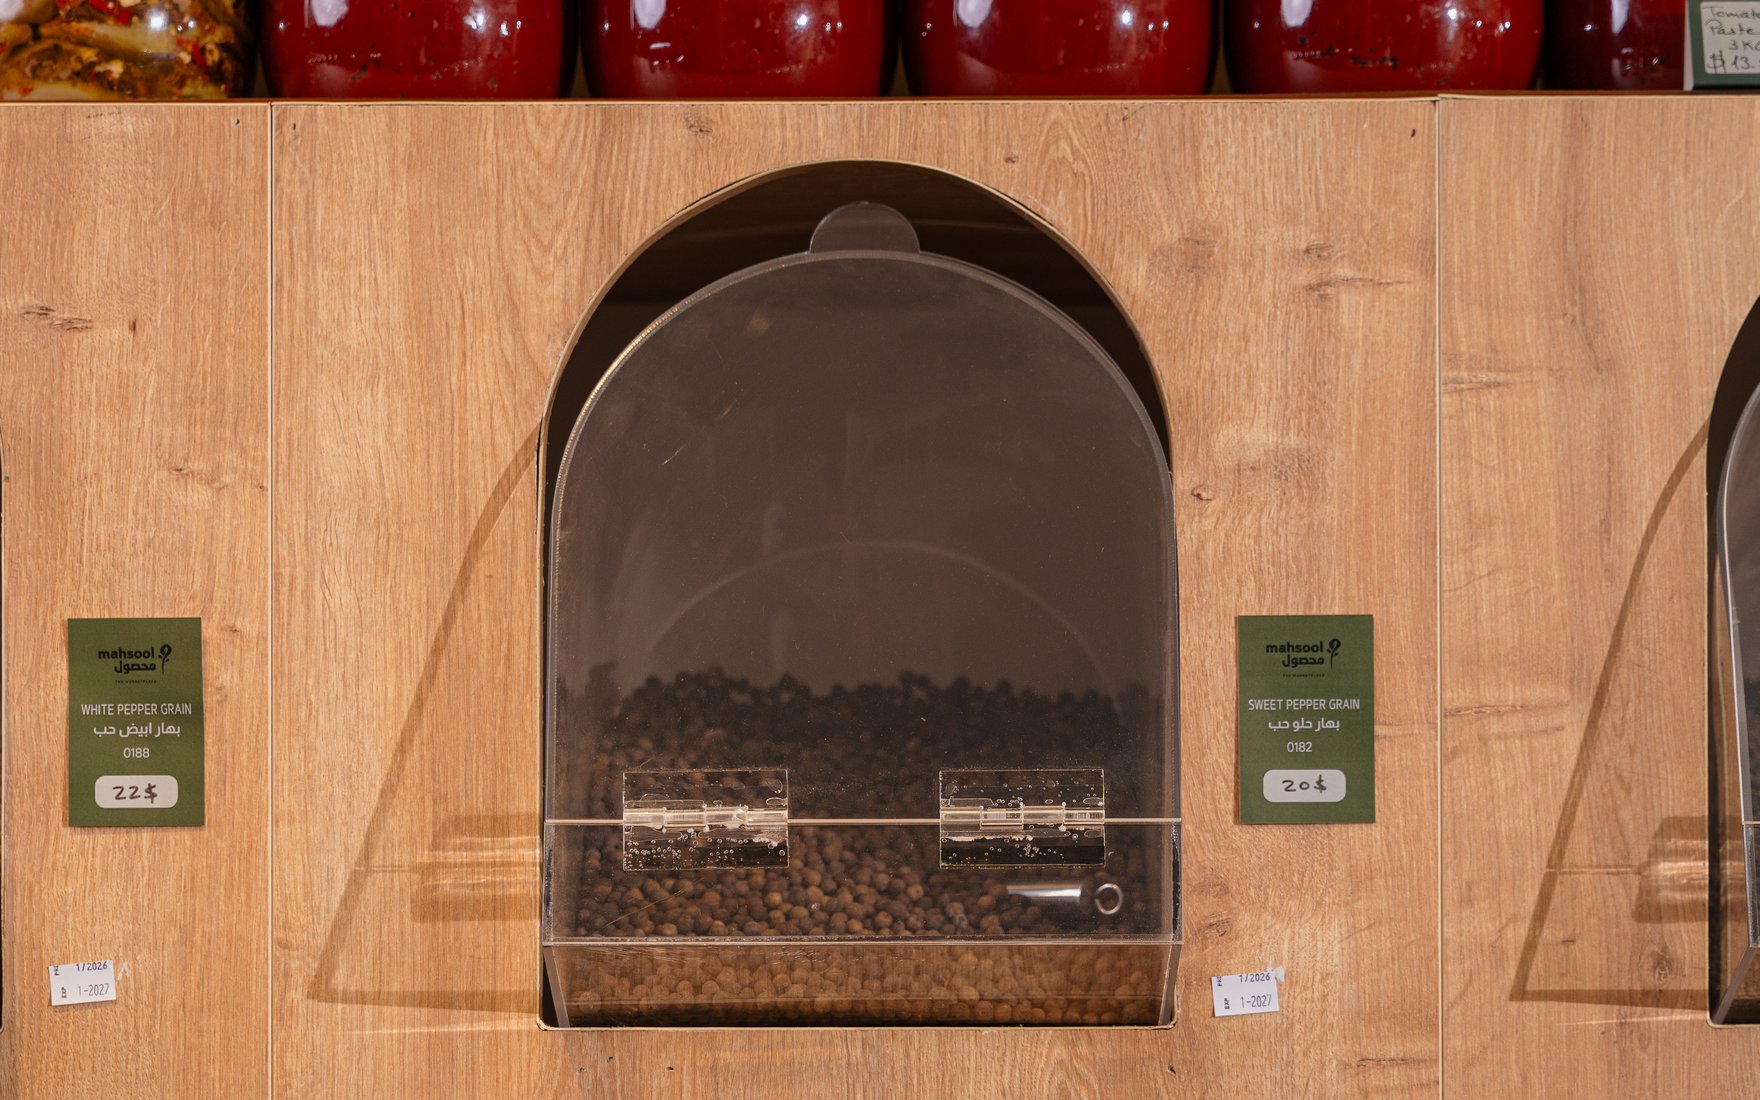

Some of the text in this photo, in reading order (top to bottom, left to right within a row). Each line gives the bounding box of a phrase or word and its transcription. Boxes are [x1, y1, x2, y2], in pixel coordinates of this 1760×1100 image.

[1704, 18, 1760, 35] Paste
[98, 647, 155, 659] mahsool
[1265, 641, 1323, 653] mahsool
[114, 660, 156, 674] محصول
[1282, 655, 1324, 668] محصول
[81, 703, 192, 716] WHITE PEPPER GRAIN
[1248, 698, 1360, 710] SWEET PEPPER GRAIN
[93, 722, 181, 738] بهار ابيض حب
[1268, 717, 1340, 732] بهار حلو حب
[123, 747, 150, 759] 0188
[1286, 741, 1313, 753] 0182
[76, 961, 108, 972] 1/2026
[1239, 973, 1271, 983] 1/2026
[78, 983, 110, 997] 1-2027
[1241, 994, 1272, 1008] 1-2027
